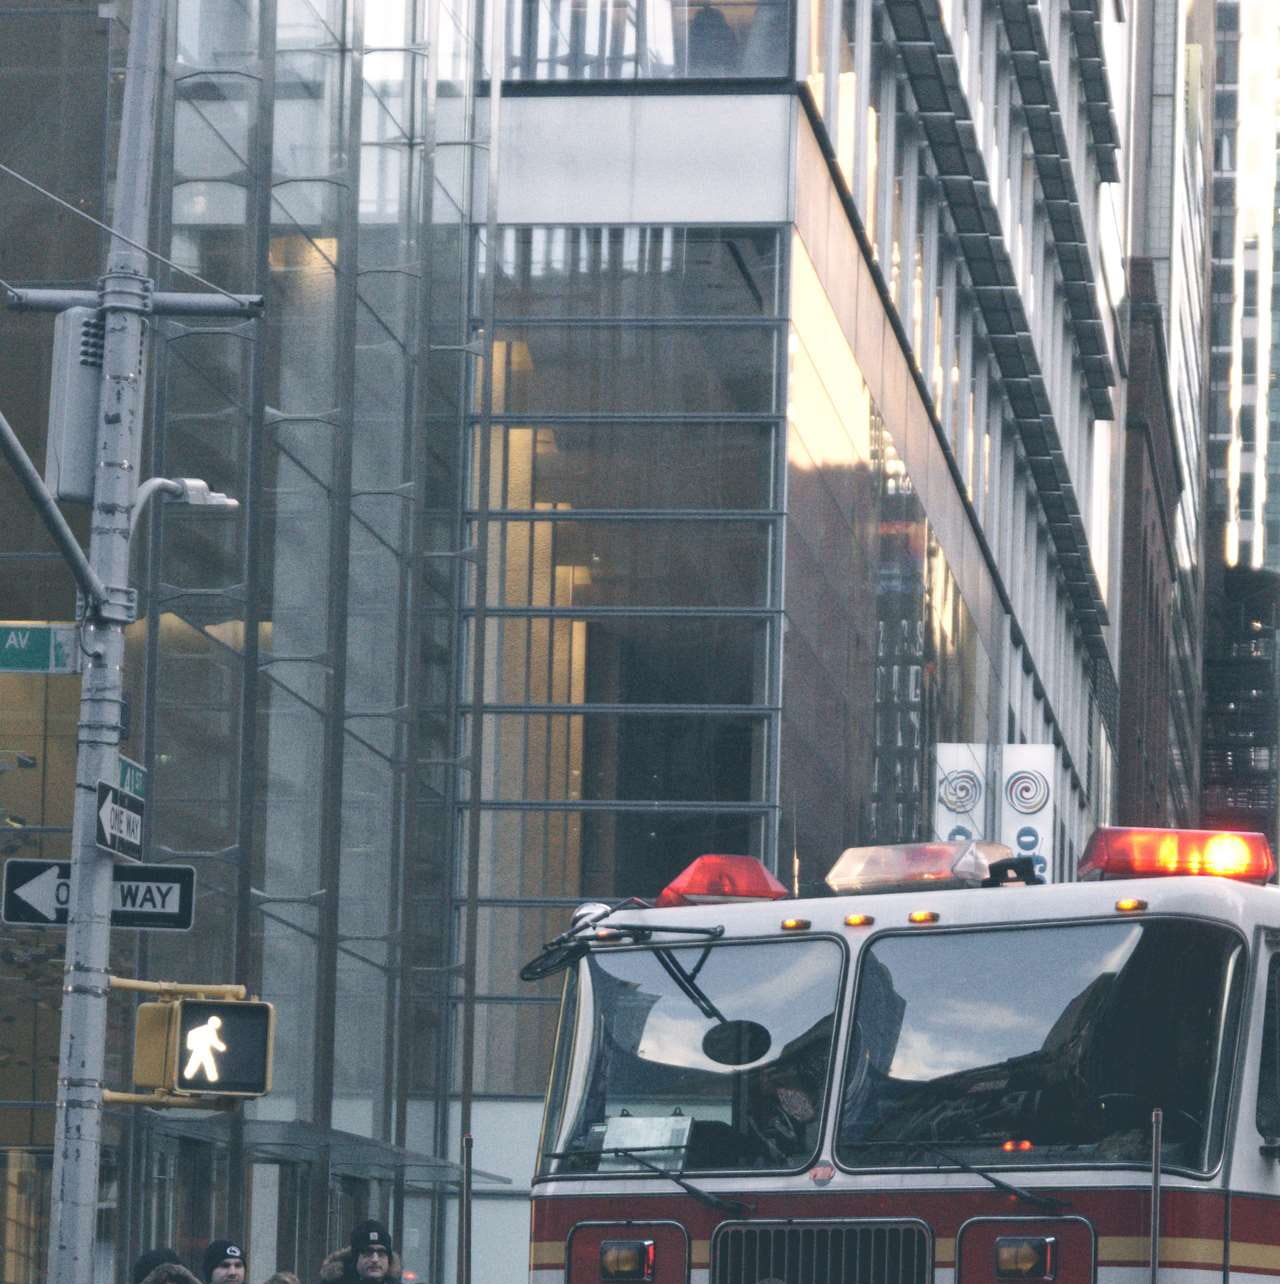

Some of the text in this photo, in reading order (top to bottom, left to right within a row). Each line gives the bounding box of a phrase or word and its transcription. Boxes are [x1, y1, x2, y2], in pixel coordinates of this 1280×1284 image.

[5, 631, 31, 650] AV
[111, 806, 140, 843] ONE WAY
[120, 884, 173, 909] WAY
